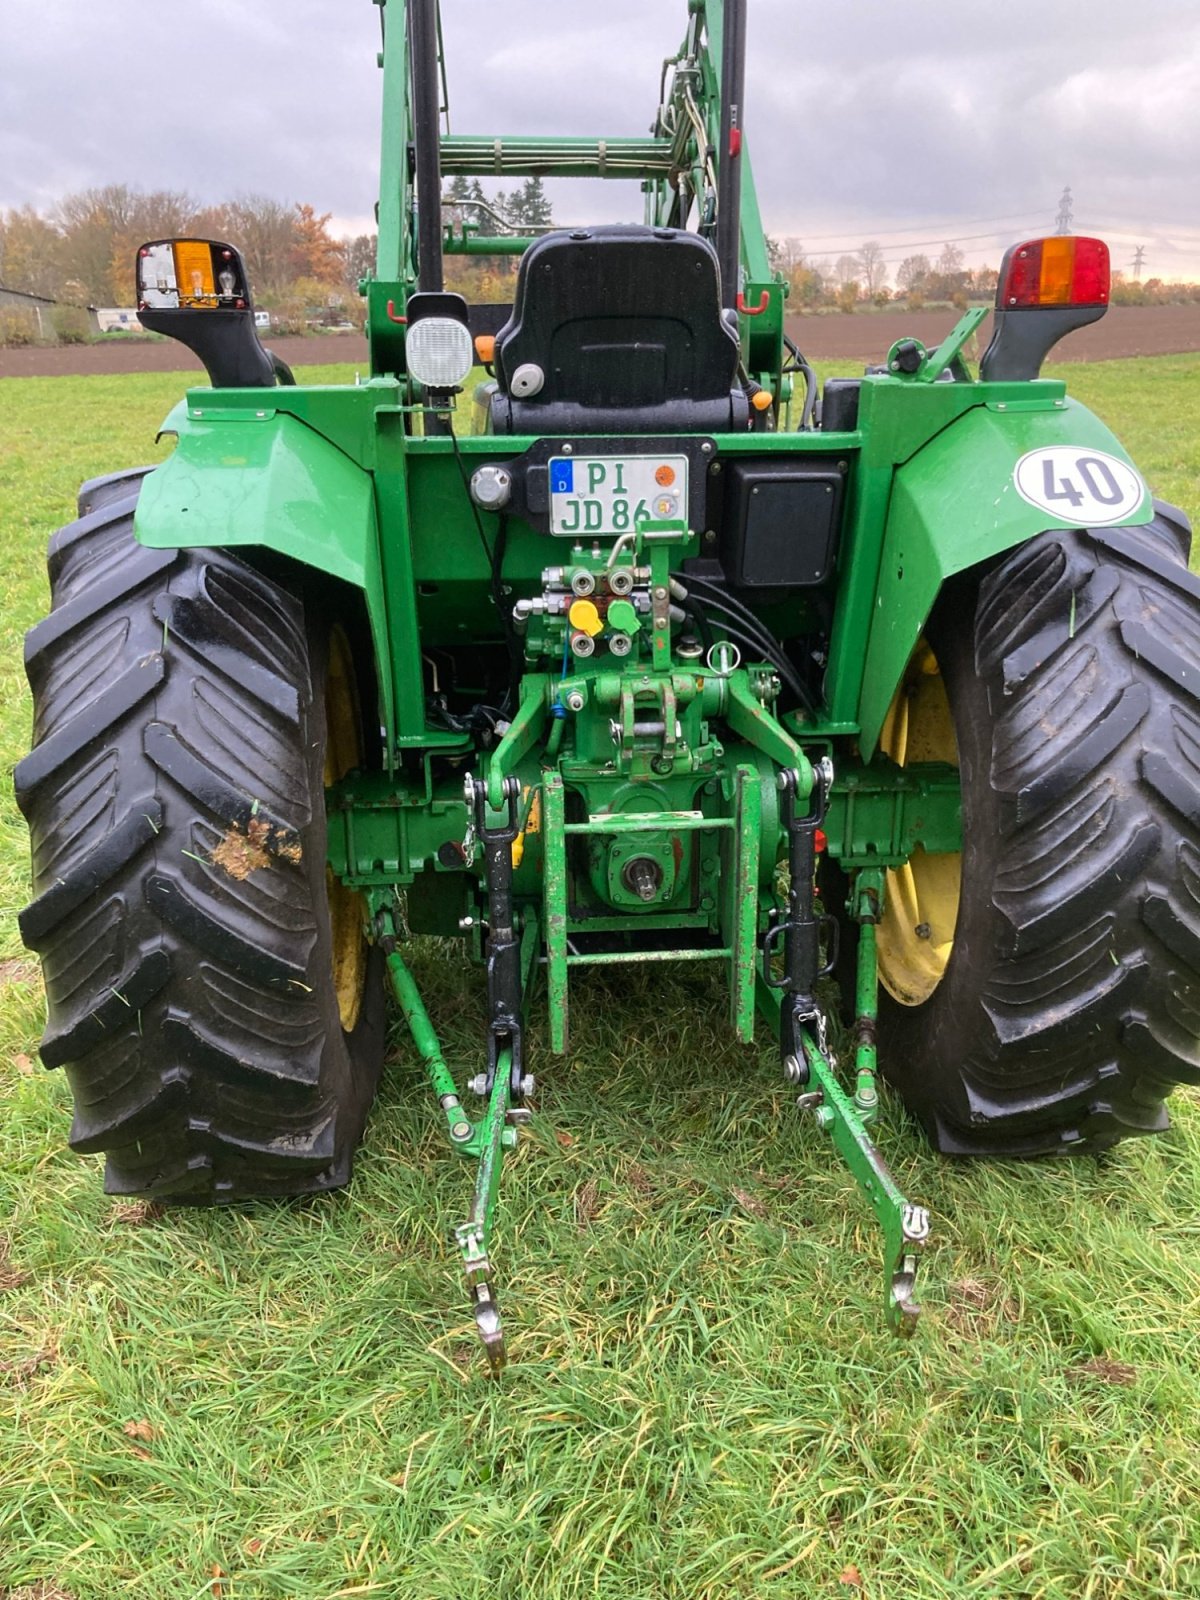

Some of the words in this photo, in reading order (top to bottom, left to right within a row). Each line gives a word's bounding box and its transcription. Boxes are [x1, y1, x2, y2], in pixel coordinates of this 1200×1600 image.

[558, 480, 567, 491] D
[587, 463, 628, 494] PI
[1042, 457, 1124, 506] 40
[561, 500, 602, 530] JD
